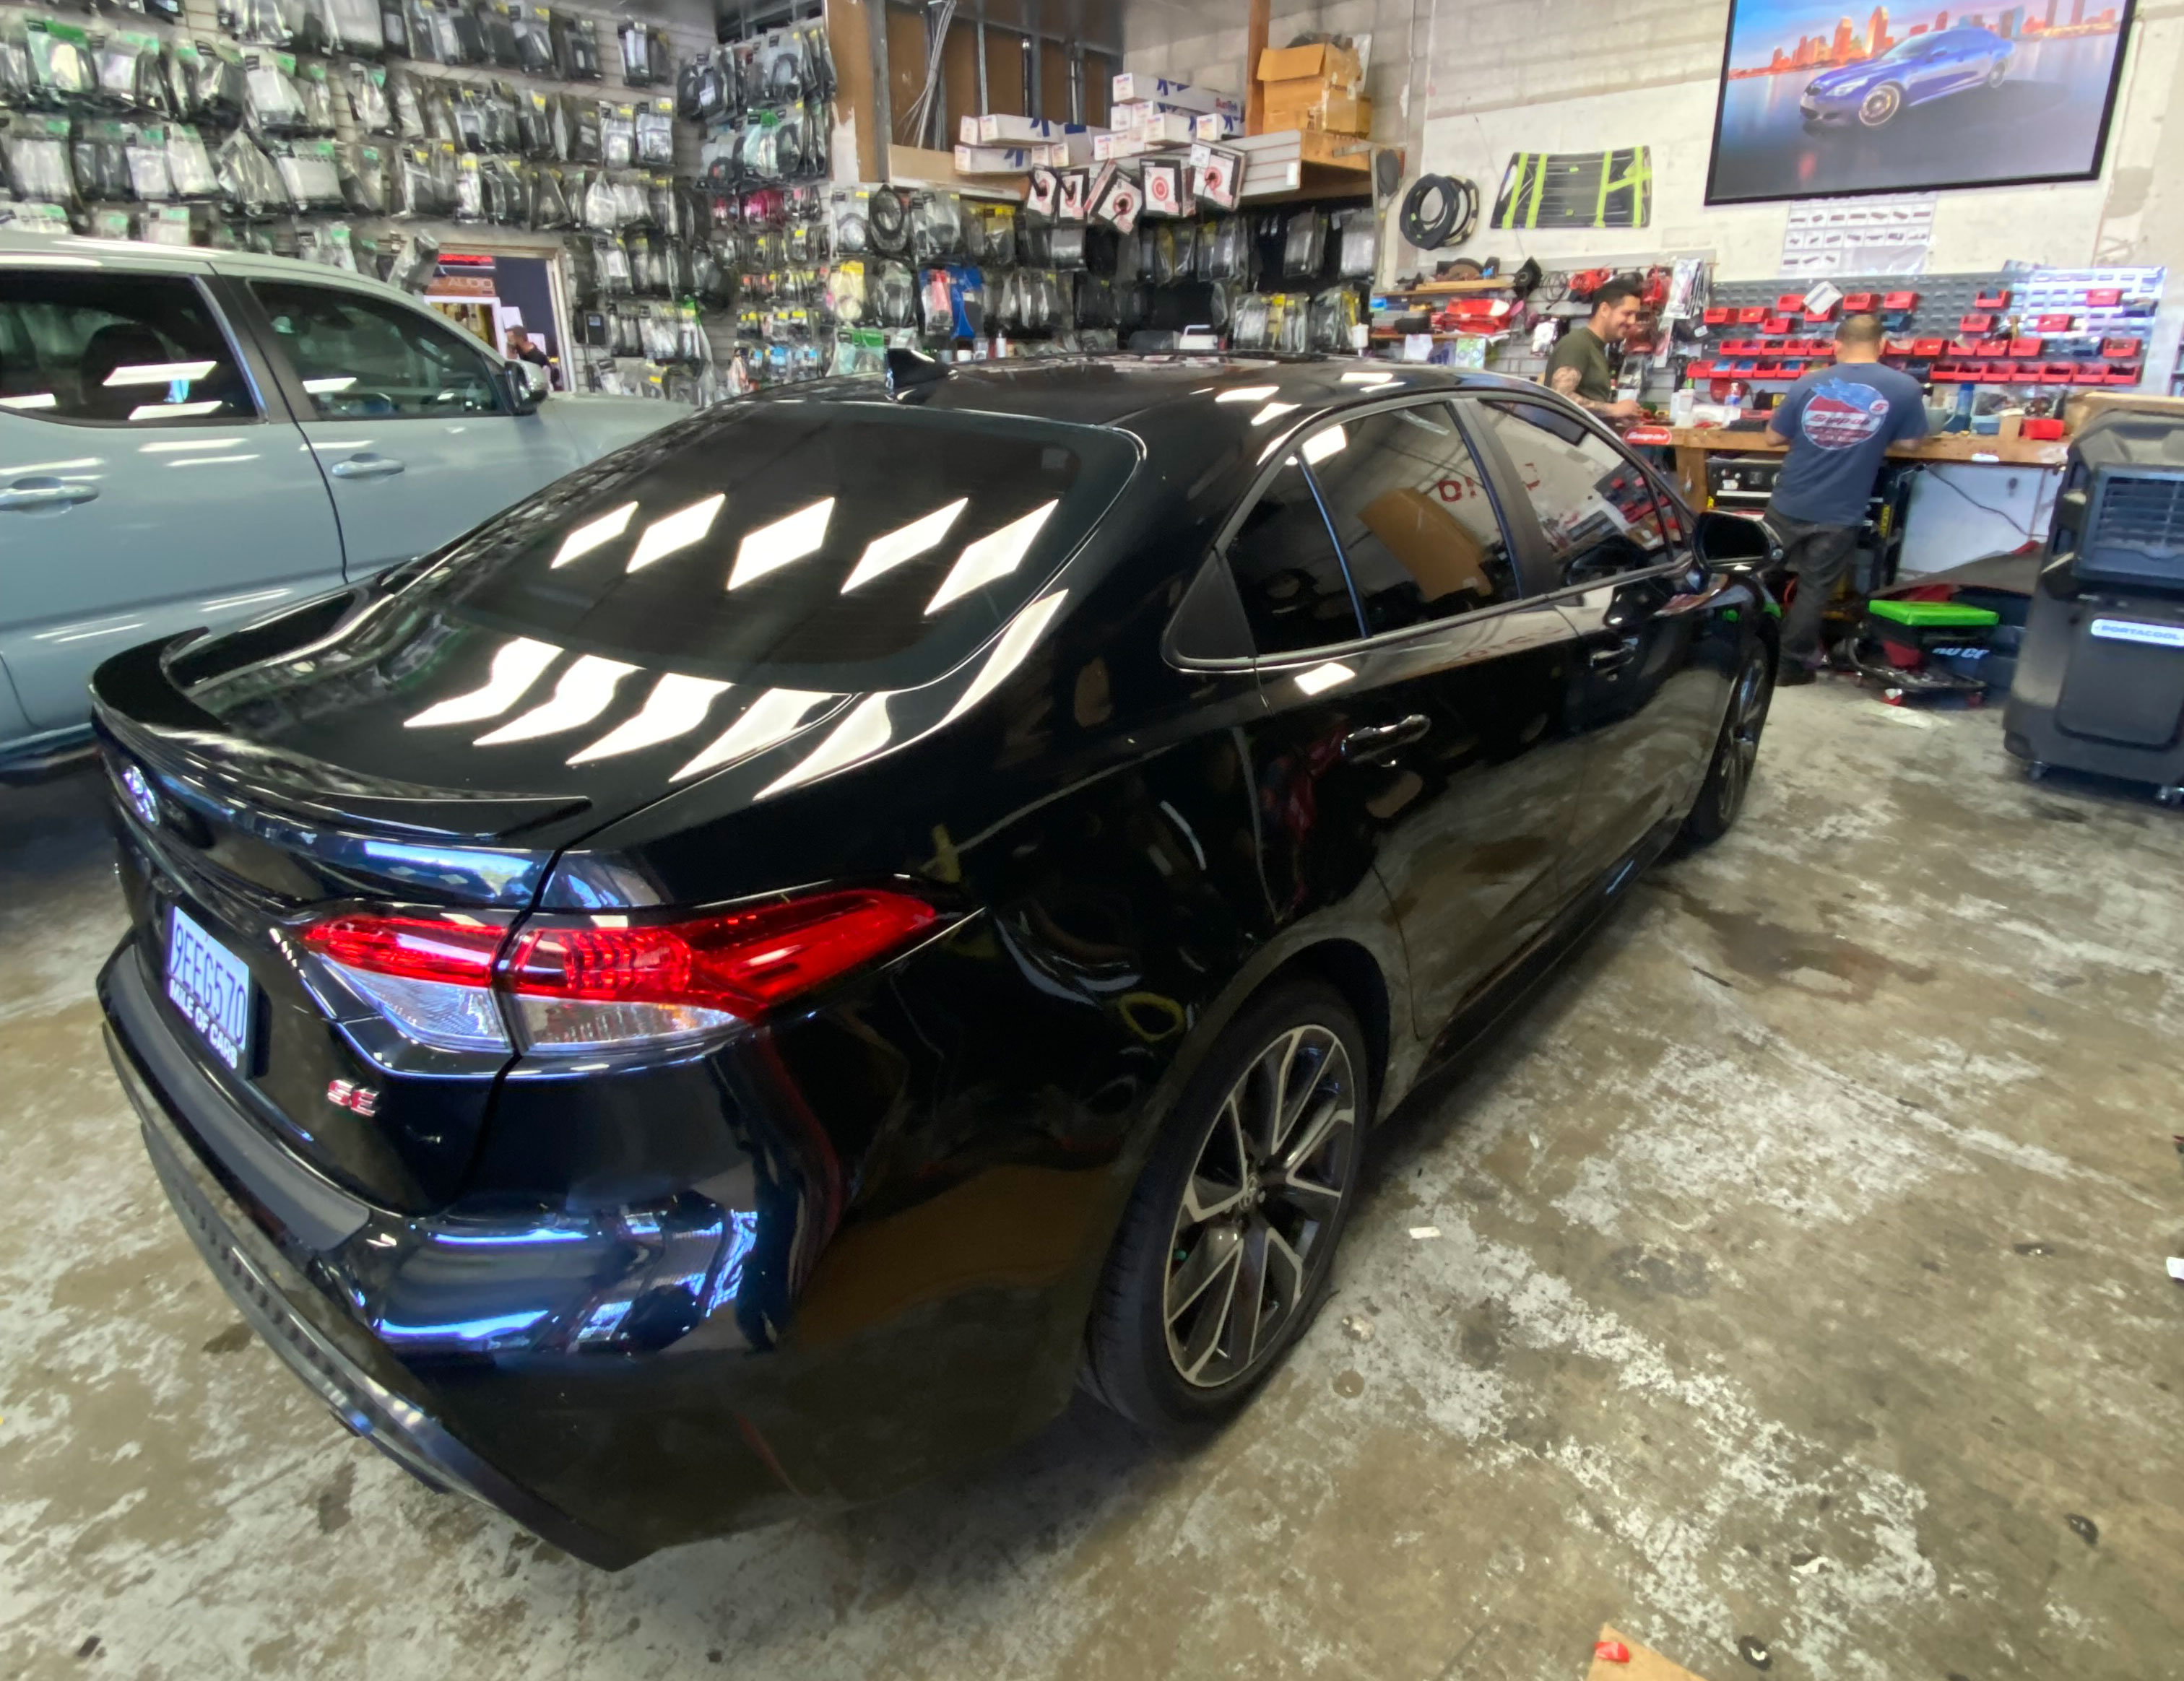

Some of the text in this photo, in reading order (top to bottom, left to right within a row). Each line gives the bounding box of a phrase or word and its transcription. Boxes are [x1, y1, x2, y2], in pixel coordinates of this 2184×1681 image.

[2101, 625, 2180, 640] PORTACOOL
[173, 924, 246, 1046] 9EEG570
[169, 978, 238, 1069] MILE OF CARS
[326, 1079, 379, 1117] SE
